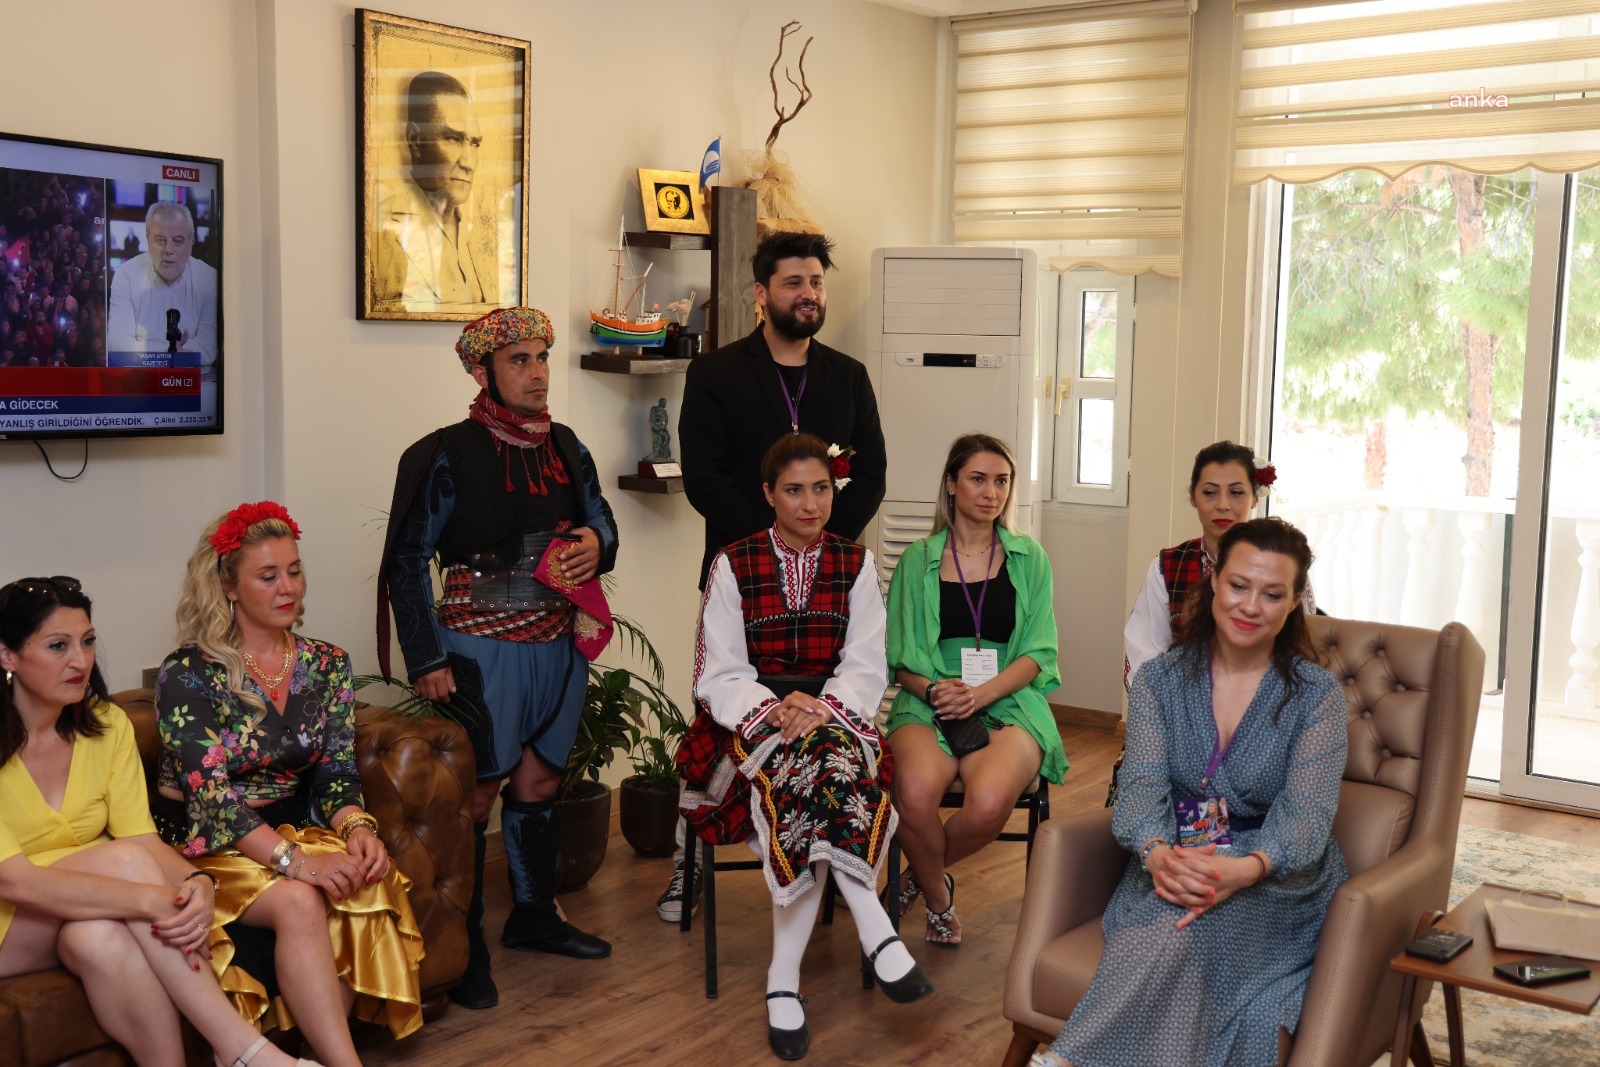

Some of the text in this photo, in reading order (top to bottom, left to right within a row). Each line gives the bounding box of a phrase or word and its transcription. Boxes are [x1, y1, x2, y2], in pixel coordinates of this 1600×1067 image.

[166, 168, 196, 180] CANLI
[162, 376, 182, 387] GÜN
[9, 398, 59, 410] GİDECEK
[0, 419, 35, 430] YANLIŞ
[37, 416, 92, 427] GİRİLDİĞİNİ
